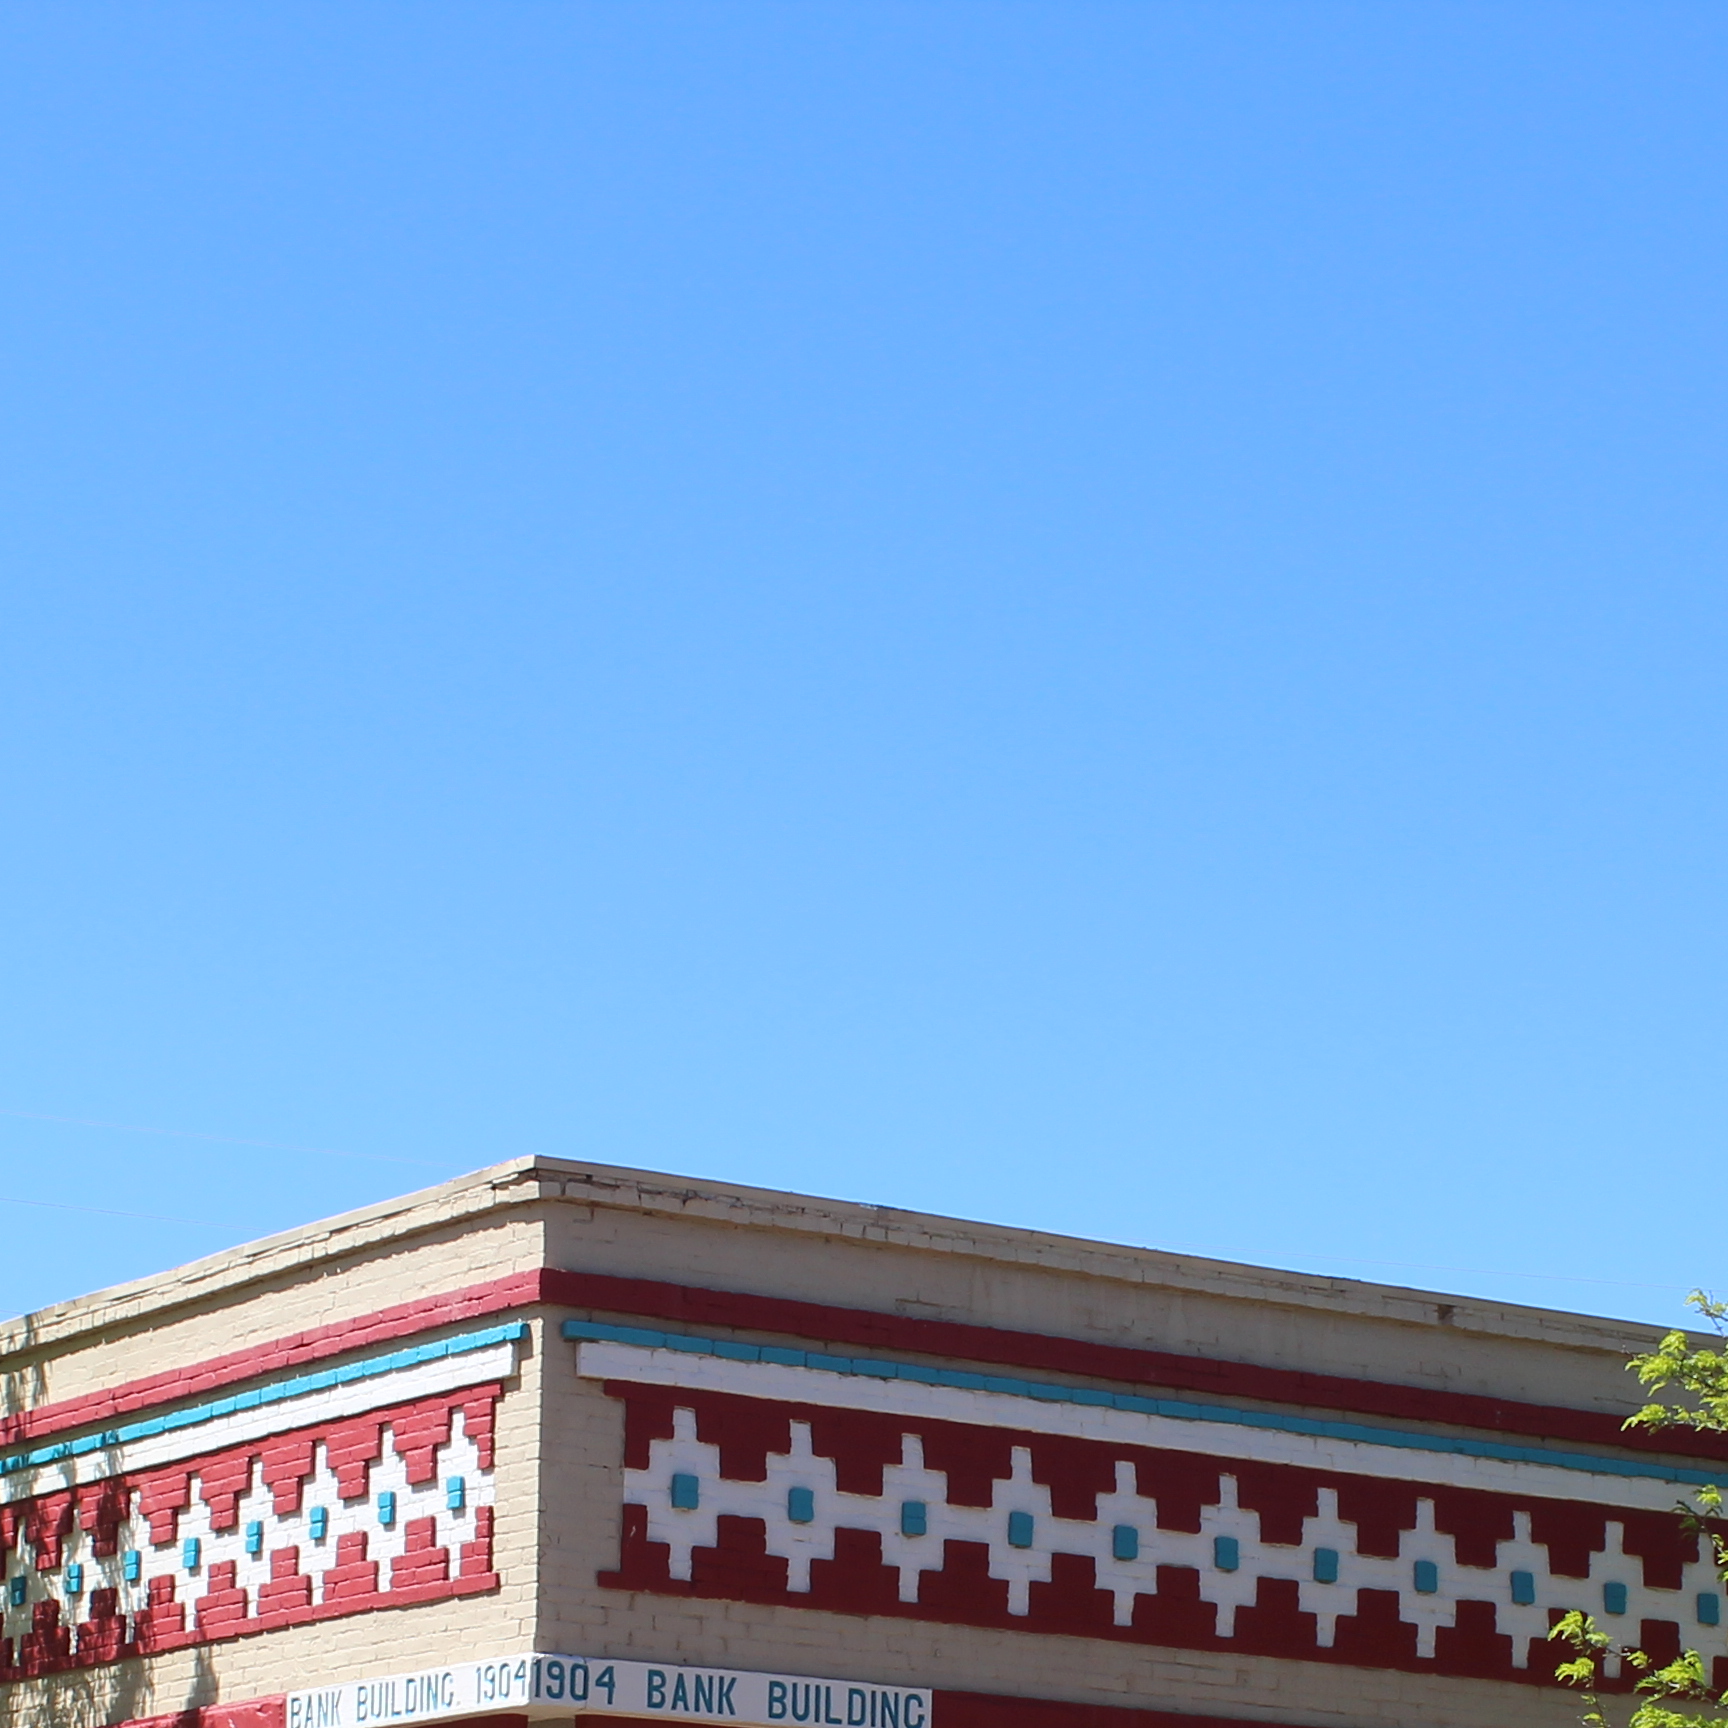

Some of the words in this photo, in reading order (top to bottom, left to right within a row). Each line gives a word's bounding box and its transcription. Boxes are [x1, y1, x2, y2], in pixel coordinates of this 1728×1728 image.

[476, 1658, 527, 1705] 1904
[534, 1659, 616, 1706] 1904
[647, 1668, 738, 1716] BANK
